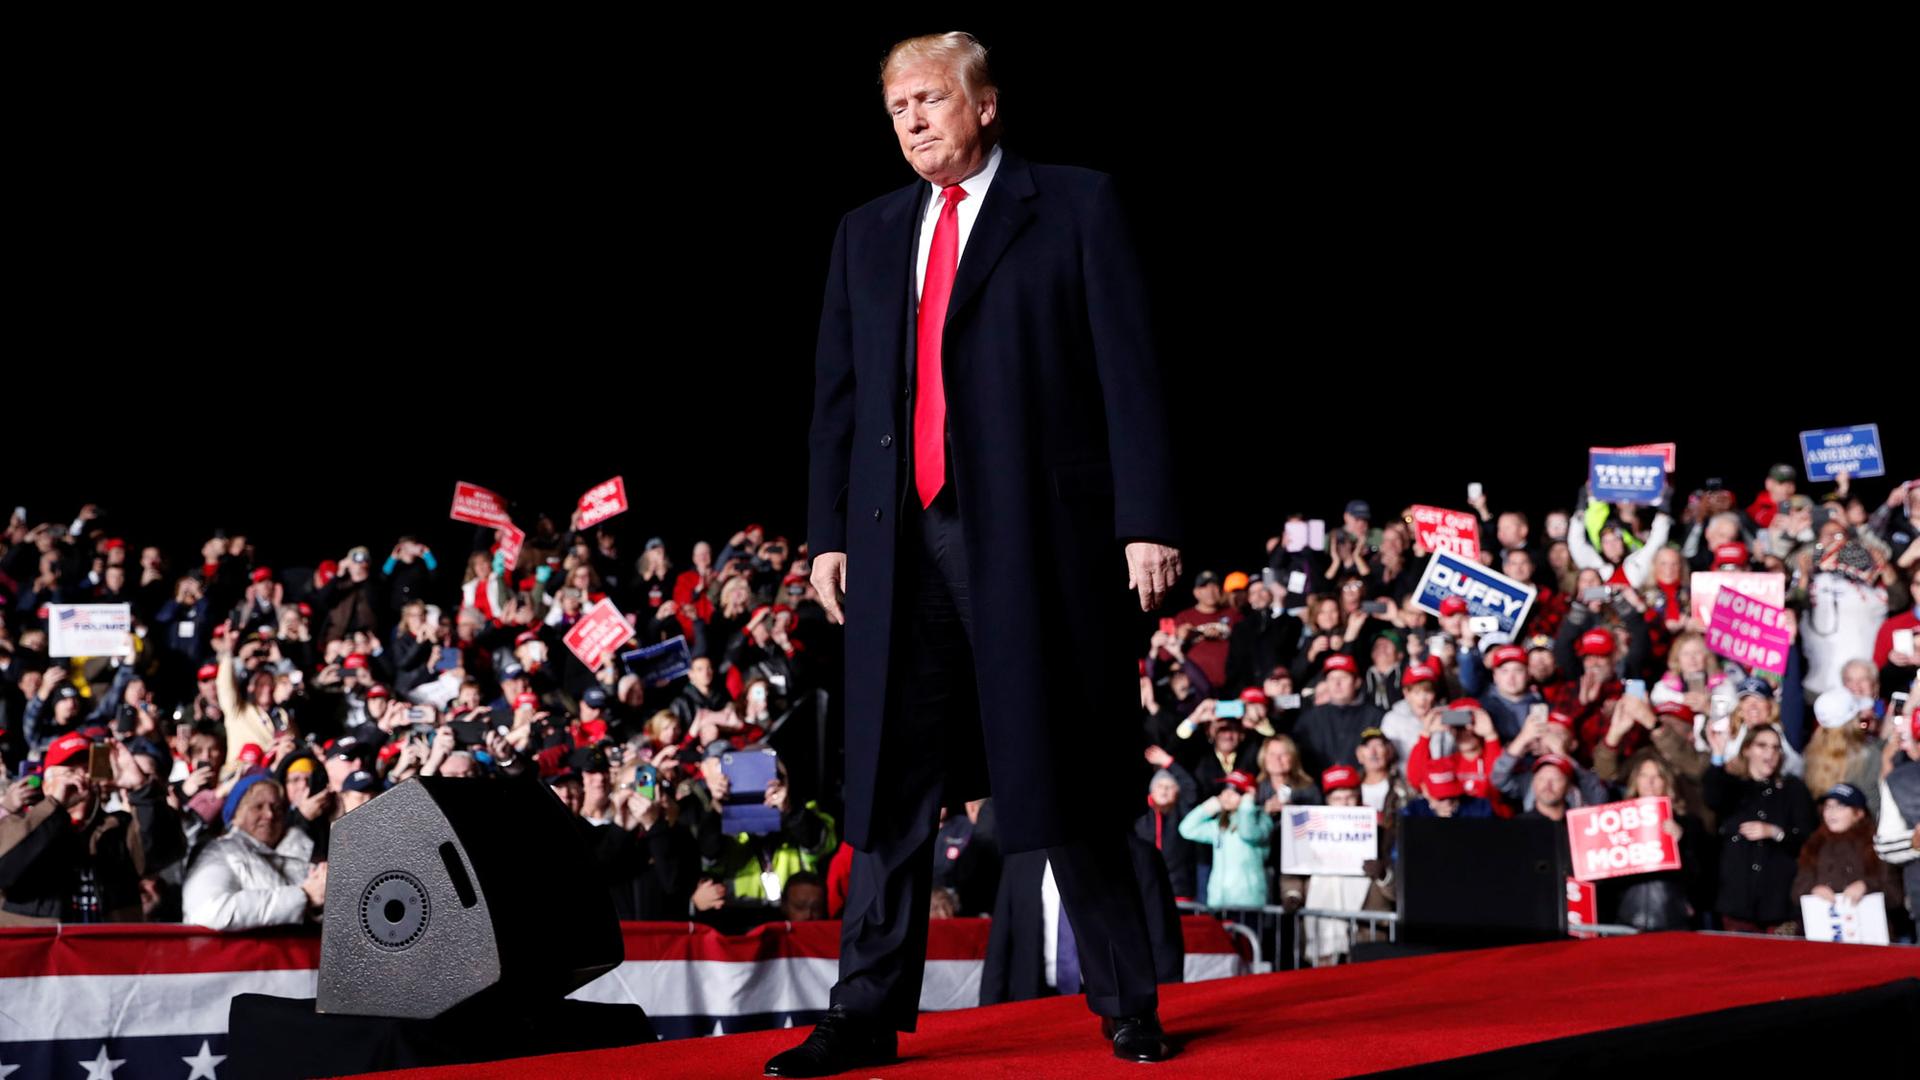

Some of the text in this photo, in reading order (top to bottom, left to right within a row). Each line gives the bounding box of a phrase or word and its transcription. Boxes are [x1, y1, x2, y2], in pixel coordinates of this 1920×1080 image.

[1807, 444, 1878, 464] AMERICA
[1595, 464, 1660, 479] TRUMP
[1415, 508, 1474, 531] GET OUT
[1421, 530, 1476, 558] VOTE
[1429, 562, 1522, 617] DUFFY
[1731, 619, 1762, 640] FOR
[1710, 628, 1782, 667] TRUMP
[1584, 804, 1659, 836] JOBS
[1308, 830, 1373, 842] TRUMP
[1586, 840, 1665, 873] MOBS
